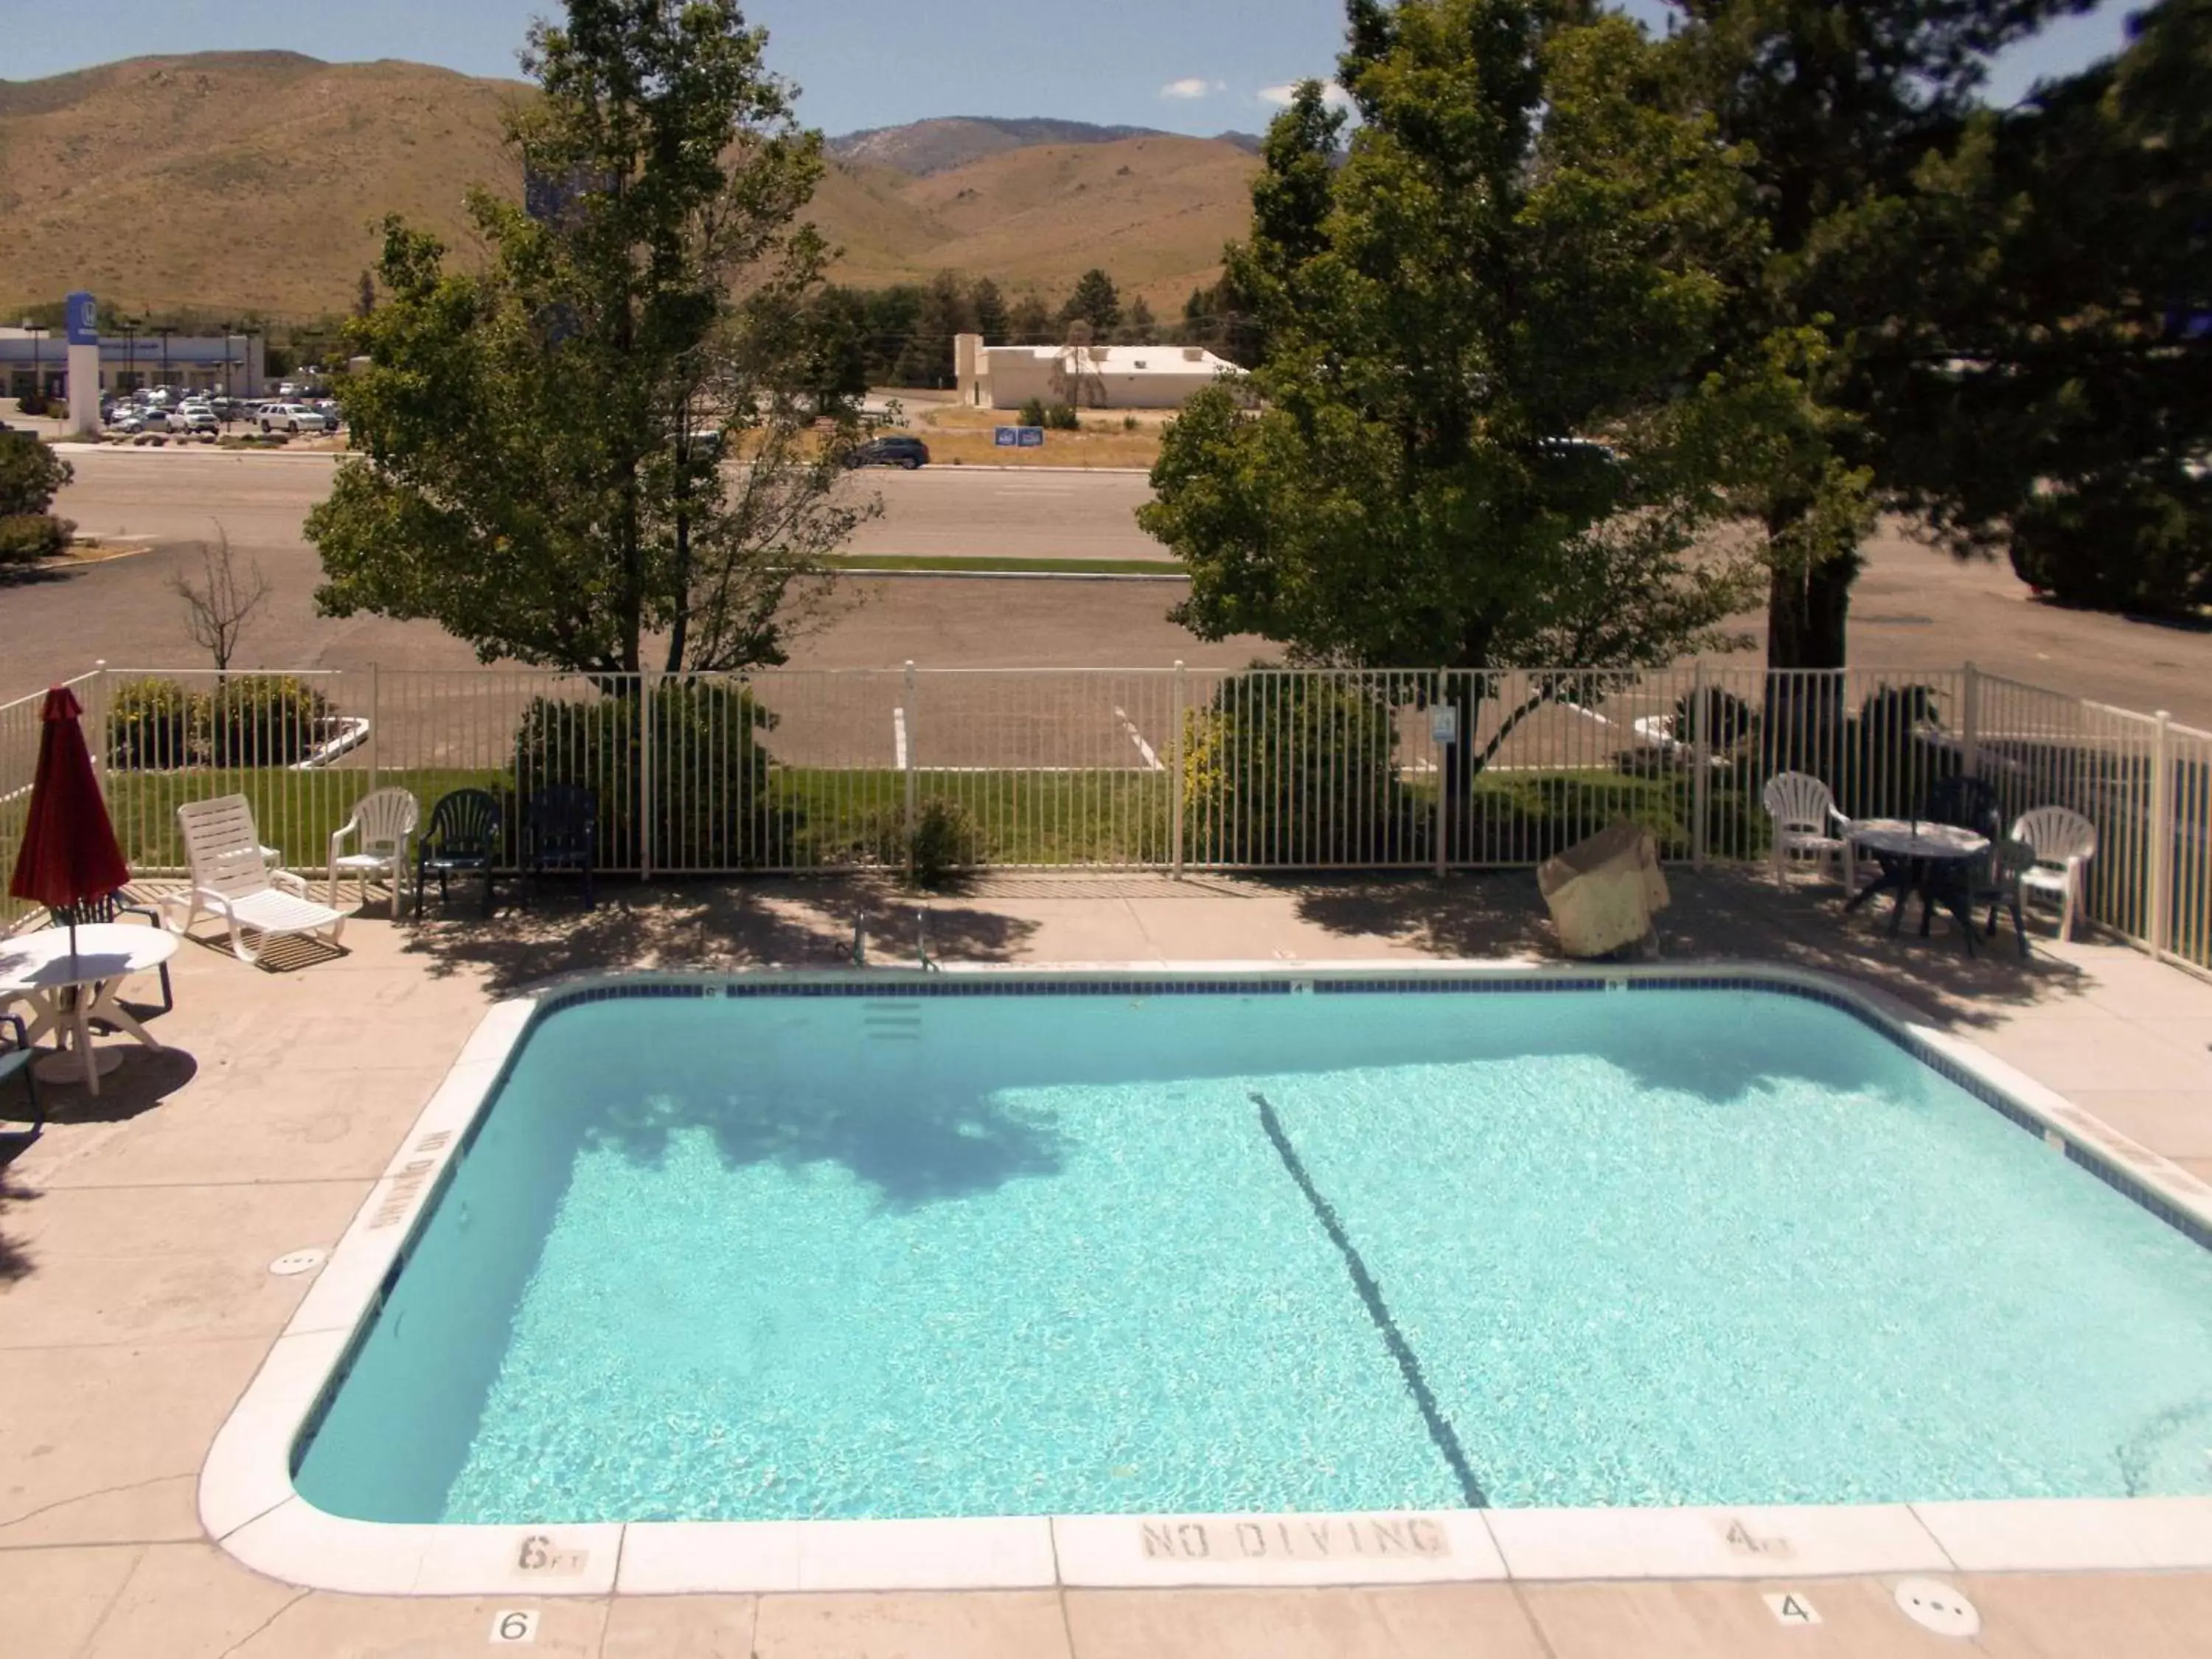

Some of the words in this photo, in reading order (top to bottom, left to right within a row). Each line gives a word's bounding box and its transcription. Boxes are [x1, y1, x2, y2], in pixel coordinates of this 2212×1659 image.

[519, 1536, 549, 1569] 6
[1143, 1523, 1209, 1557] NO
[1235, 1518, 1440, 1557] DIVING
[1782, 1595, 1809, 1621] 4
[500, 1613, 528, 1640] 6
